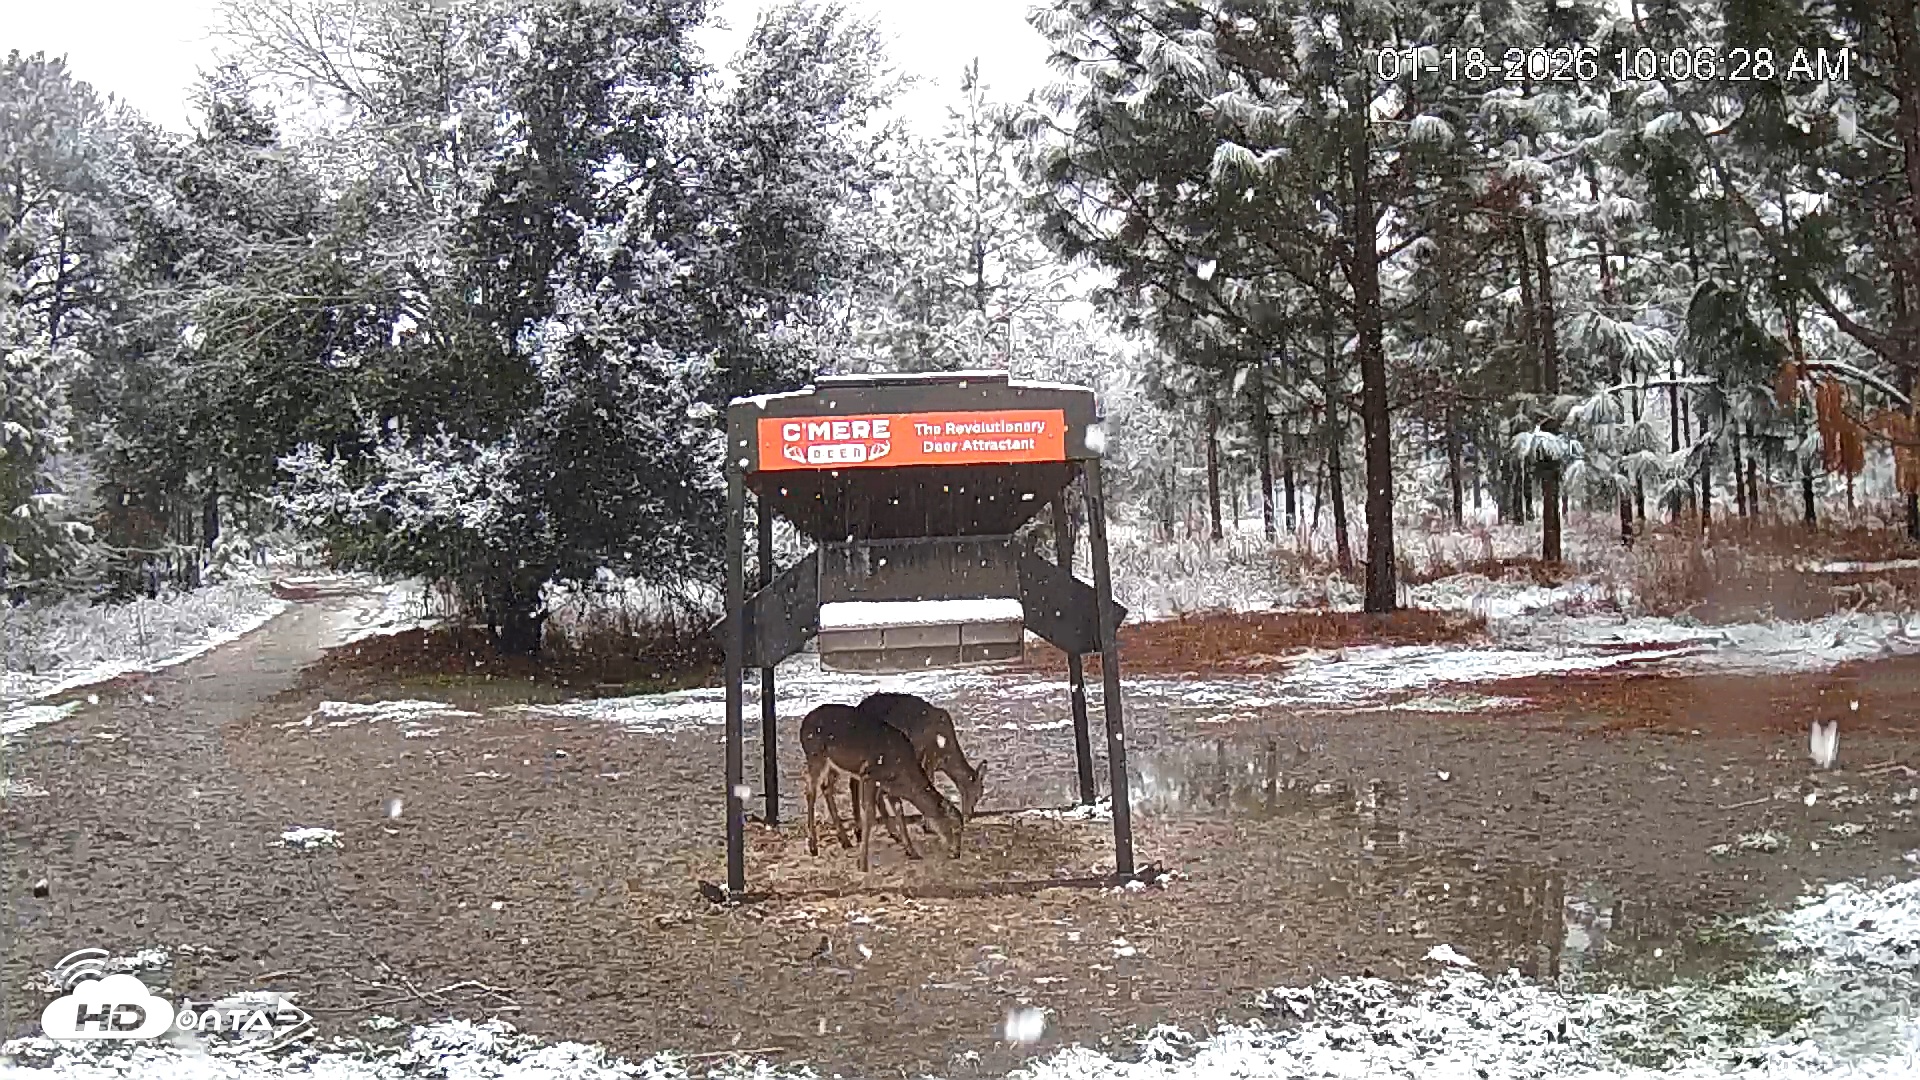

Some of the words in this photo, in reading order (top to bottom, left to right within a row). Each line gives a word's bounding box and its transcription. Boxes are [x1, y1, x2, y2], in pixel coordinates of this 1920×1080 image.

[782, 419, 891, 442] C'MERE
[914, 423, 941, 435] The
[945, 420, 1045, 435] Revolutionary
[961, 438, 1035, 451] Attractant
